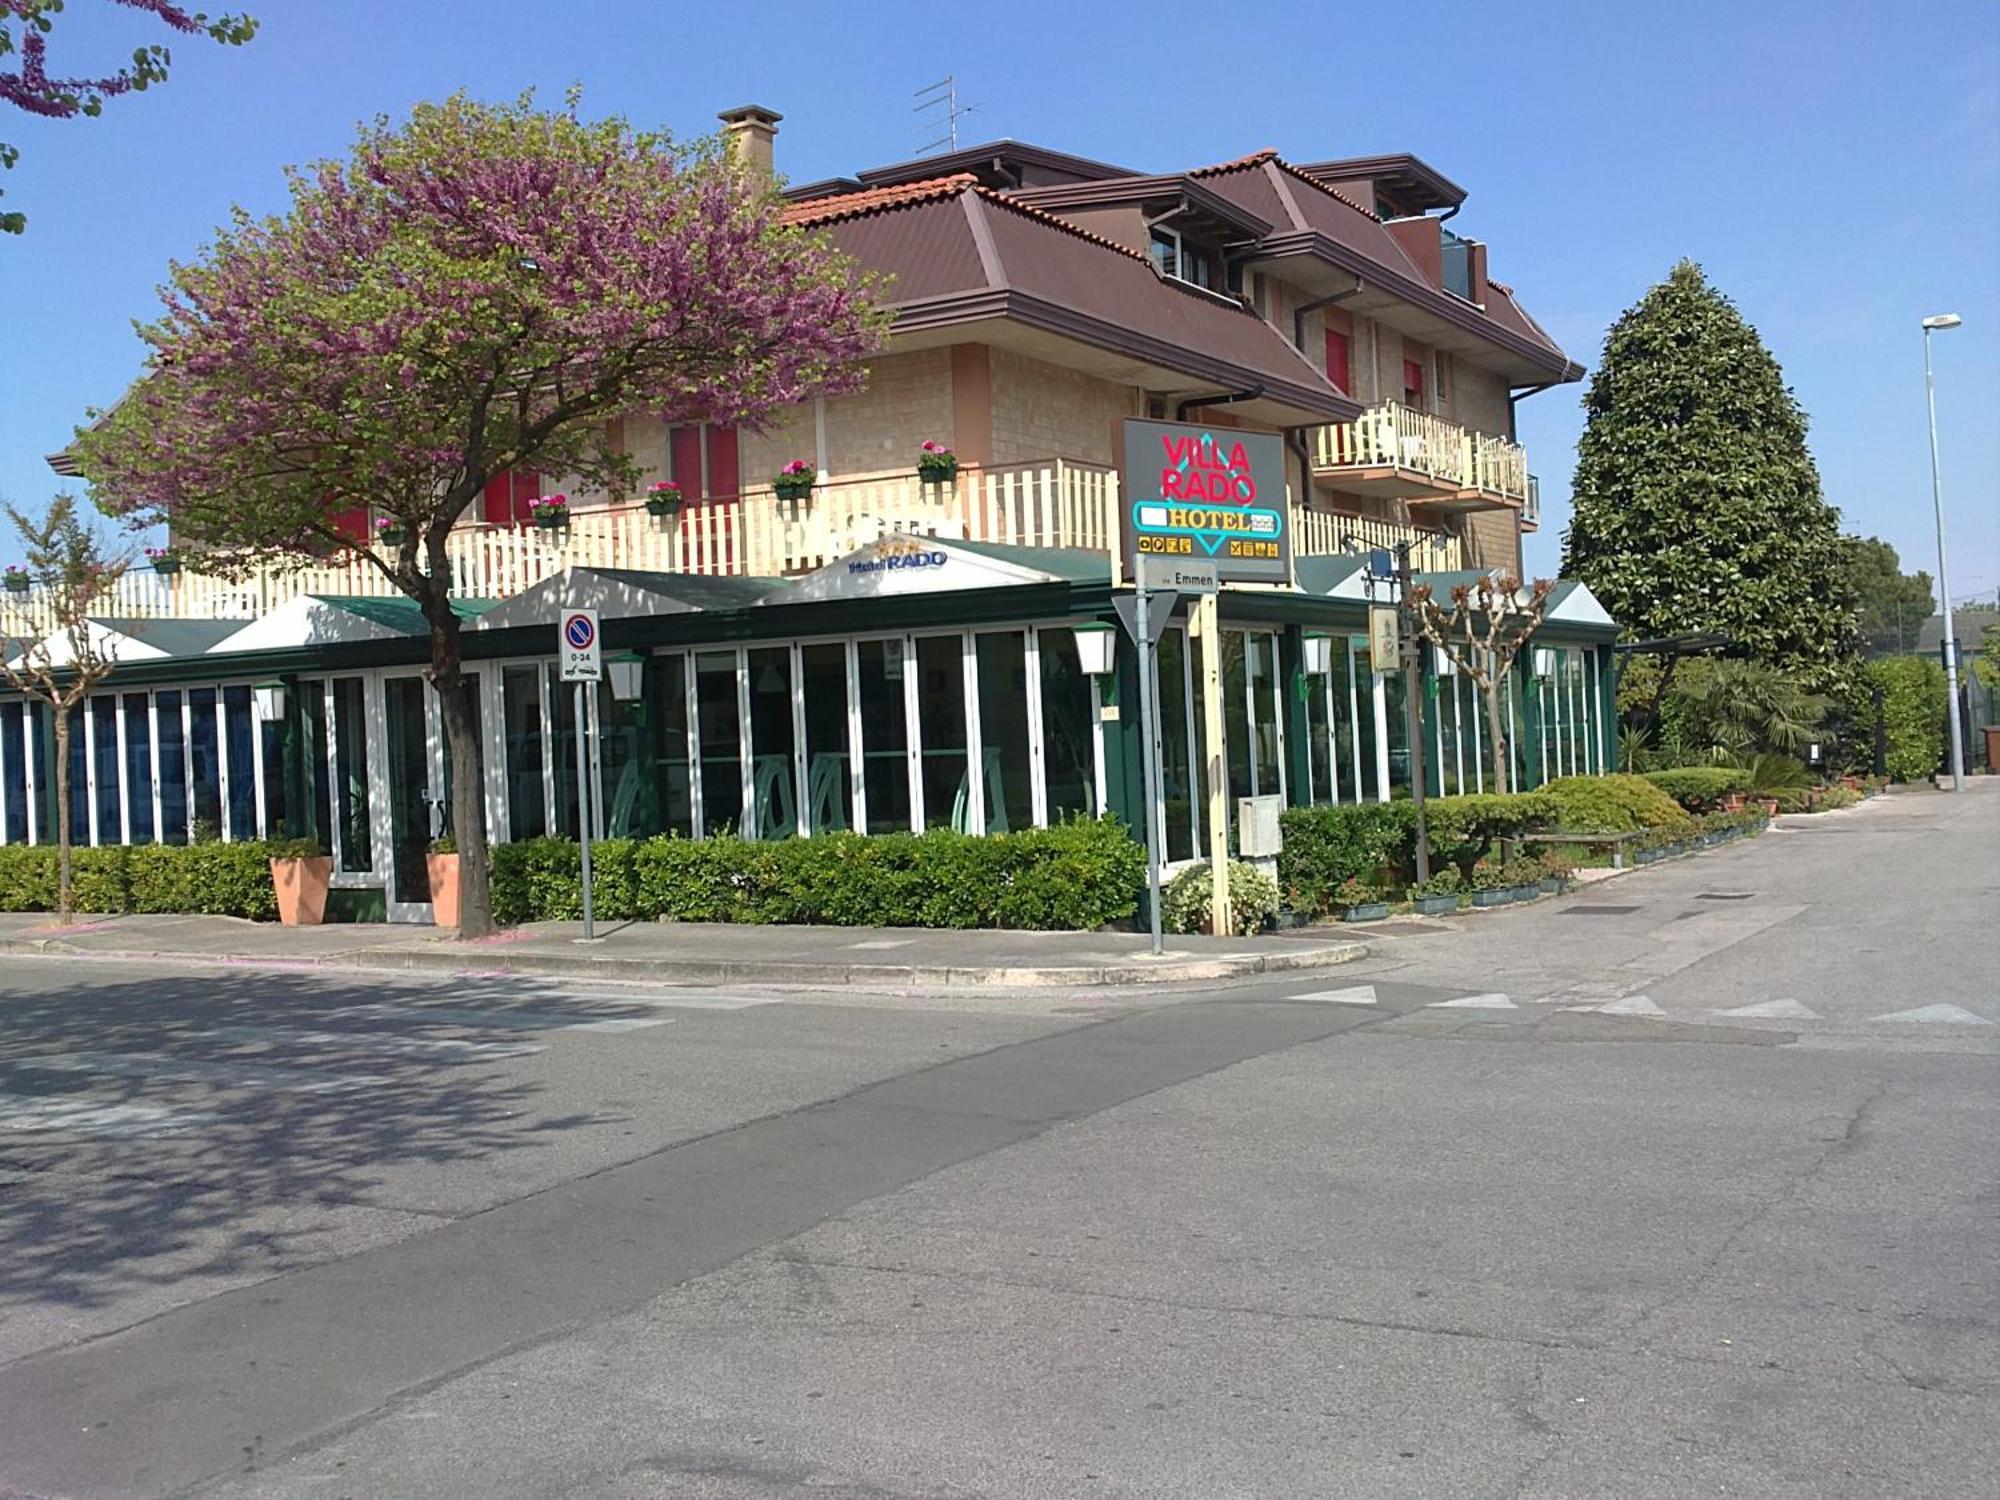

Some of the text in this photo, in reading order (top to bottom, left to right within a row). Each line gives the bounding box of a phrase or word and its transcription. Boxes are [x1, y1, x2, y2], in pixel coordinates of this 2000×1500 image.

[1162, 435, 1251, 473] VILLA
[1160, 468, 1257, 506] RADO
[1168, 508, 1251, 532] HOTEL
[887, 551, 948, 570] RADO
[1175, 571, 1213, 586] Emmen
[571, 653, 591, 662] 0-24
